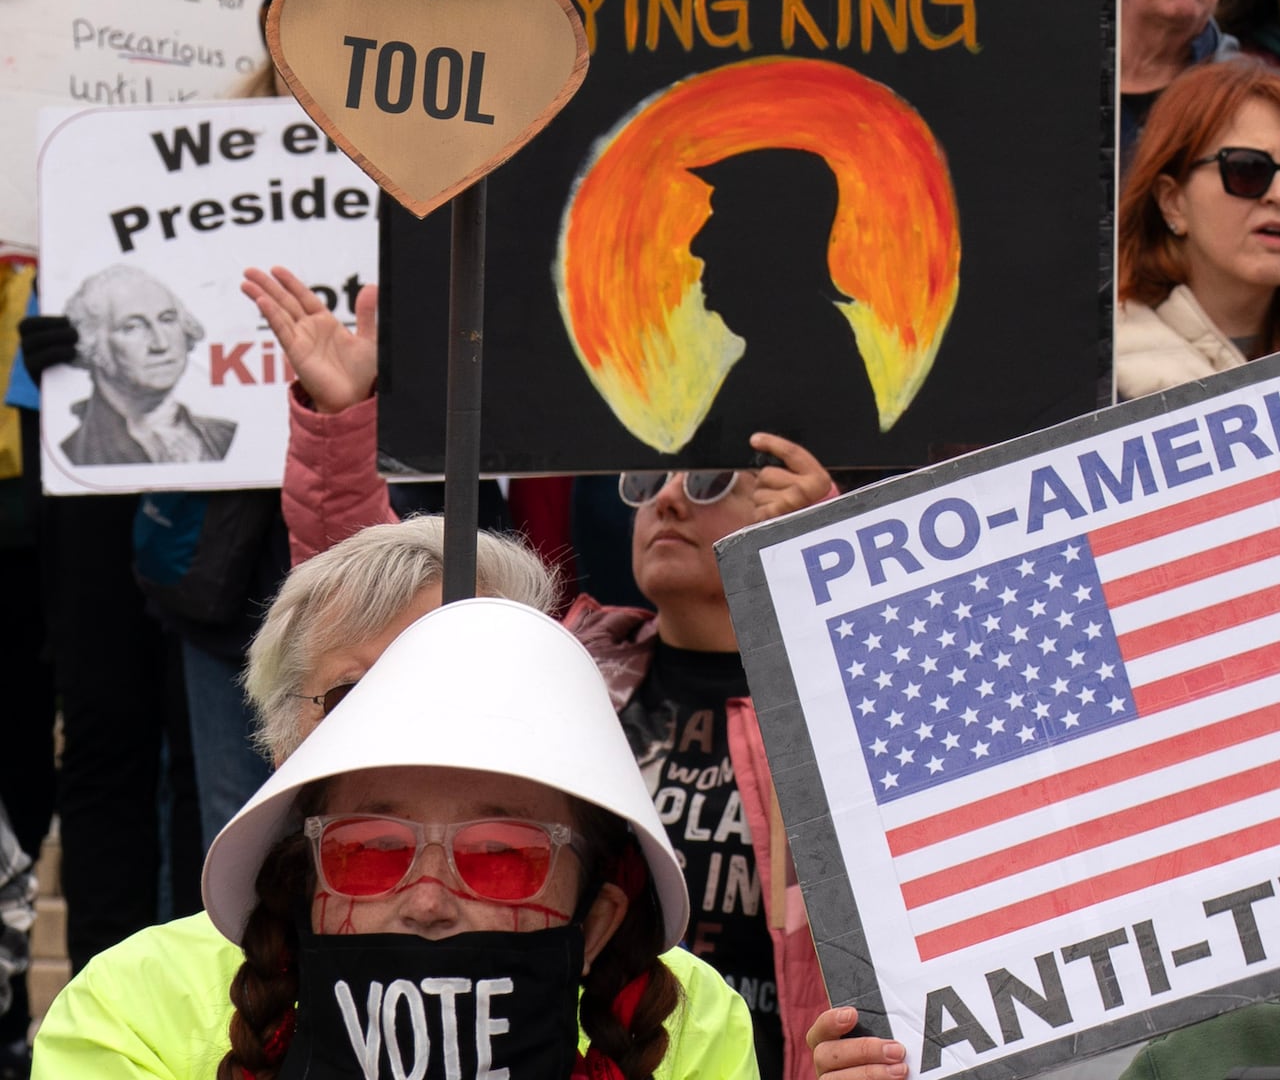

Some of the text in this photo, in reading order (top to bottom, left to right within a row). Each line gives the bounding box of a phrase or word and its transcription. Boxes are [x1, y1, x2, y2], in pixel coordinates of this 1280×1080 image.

[344, 35, 495, 125] TOOL
[151, 121, 257, 172] We
[110, 177, 380, 253] Preside
[334, 976, 514, 1080] VOTE
